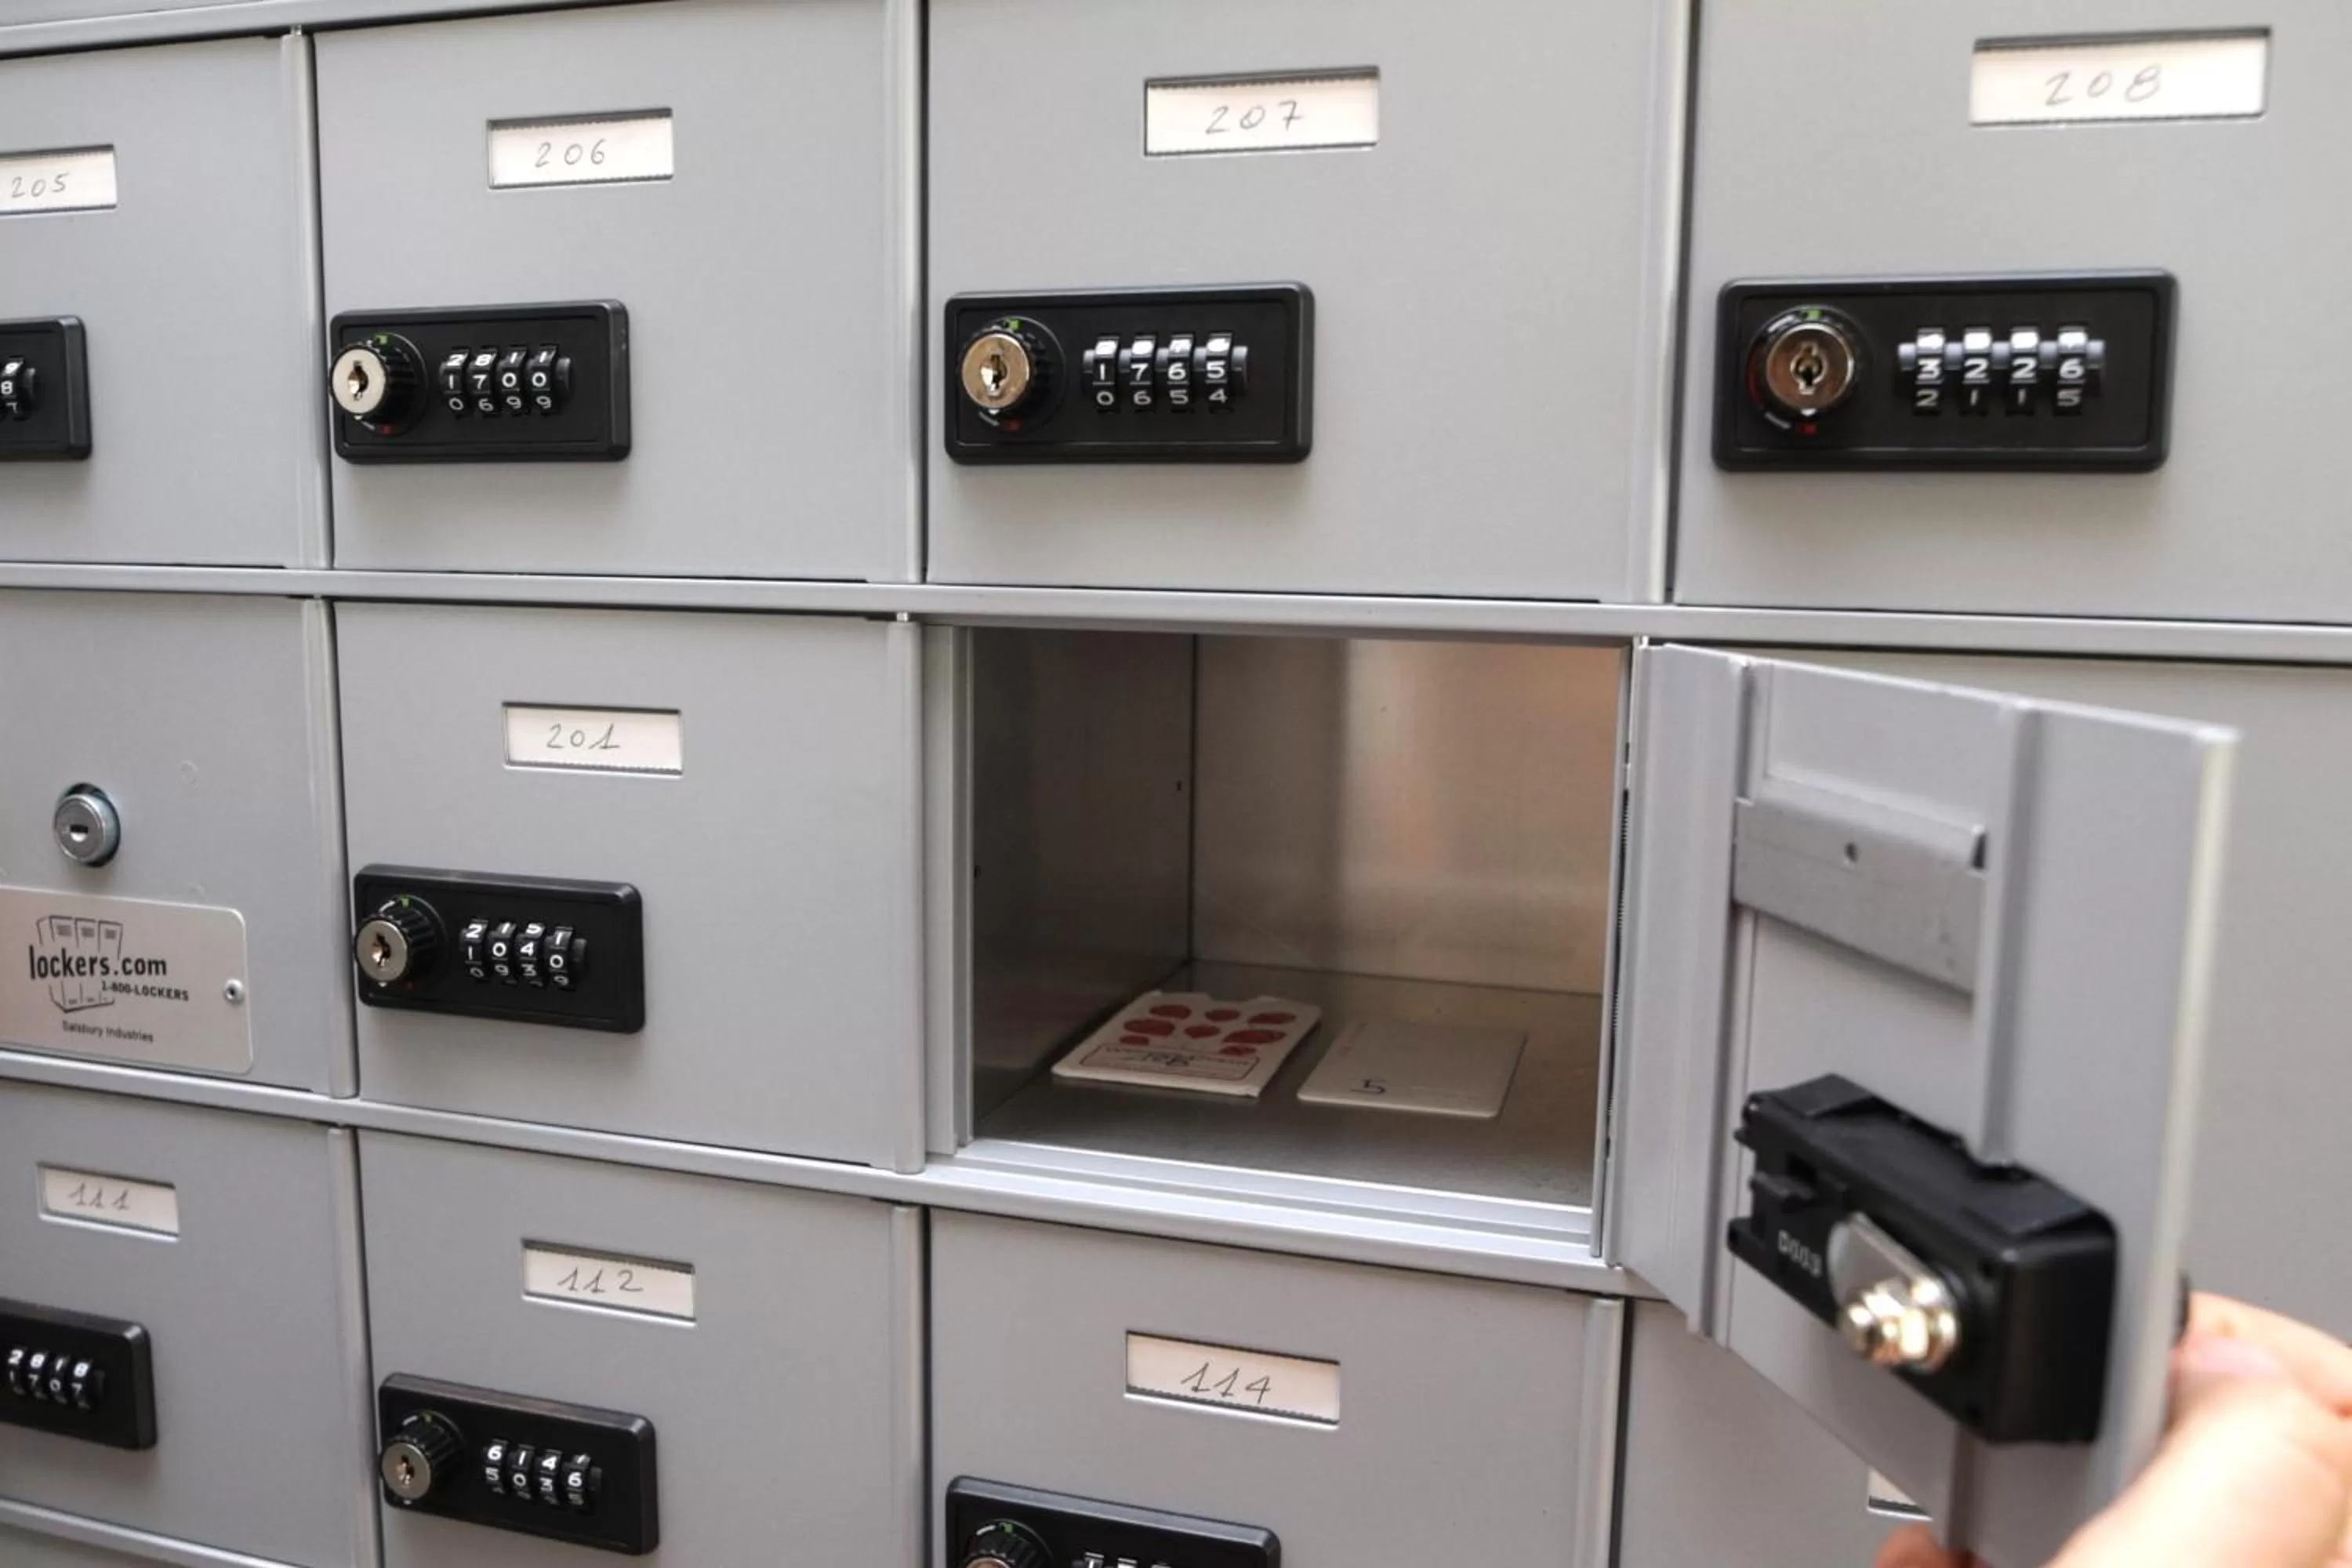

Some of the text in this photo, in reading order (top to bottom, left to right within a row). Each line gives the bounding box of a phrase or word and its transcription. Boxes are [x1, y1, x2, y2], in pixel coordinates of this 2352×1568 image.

[2044, 64, 2162, 107] 208
[1205, 100, 1304, 135] 207
[535, 139, 607, 168] 206
[11, 172, 70, 198] 205
[448, 371, 548, 390] 1700
[1098, 361, 1226, 383] 1765
[1917, 358, 2085, 381] 3226
[546, 723, 620, 750] 201
[29, 945, 167, 980] lockers.com
[101, 981, 189, 1001] 1-800-LOCKERS
[106, 1025, 154, 1044] Industries
[68, 1182, 130, 1210] 111
[557, 1266, 644, 1293] 112
[1180, 1361, 1272, 1403] 114
